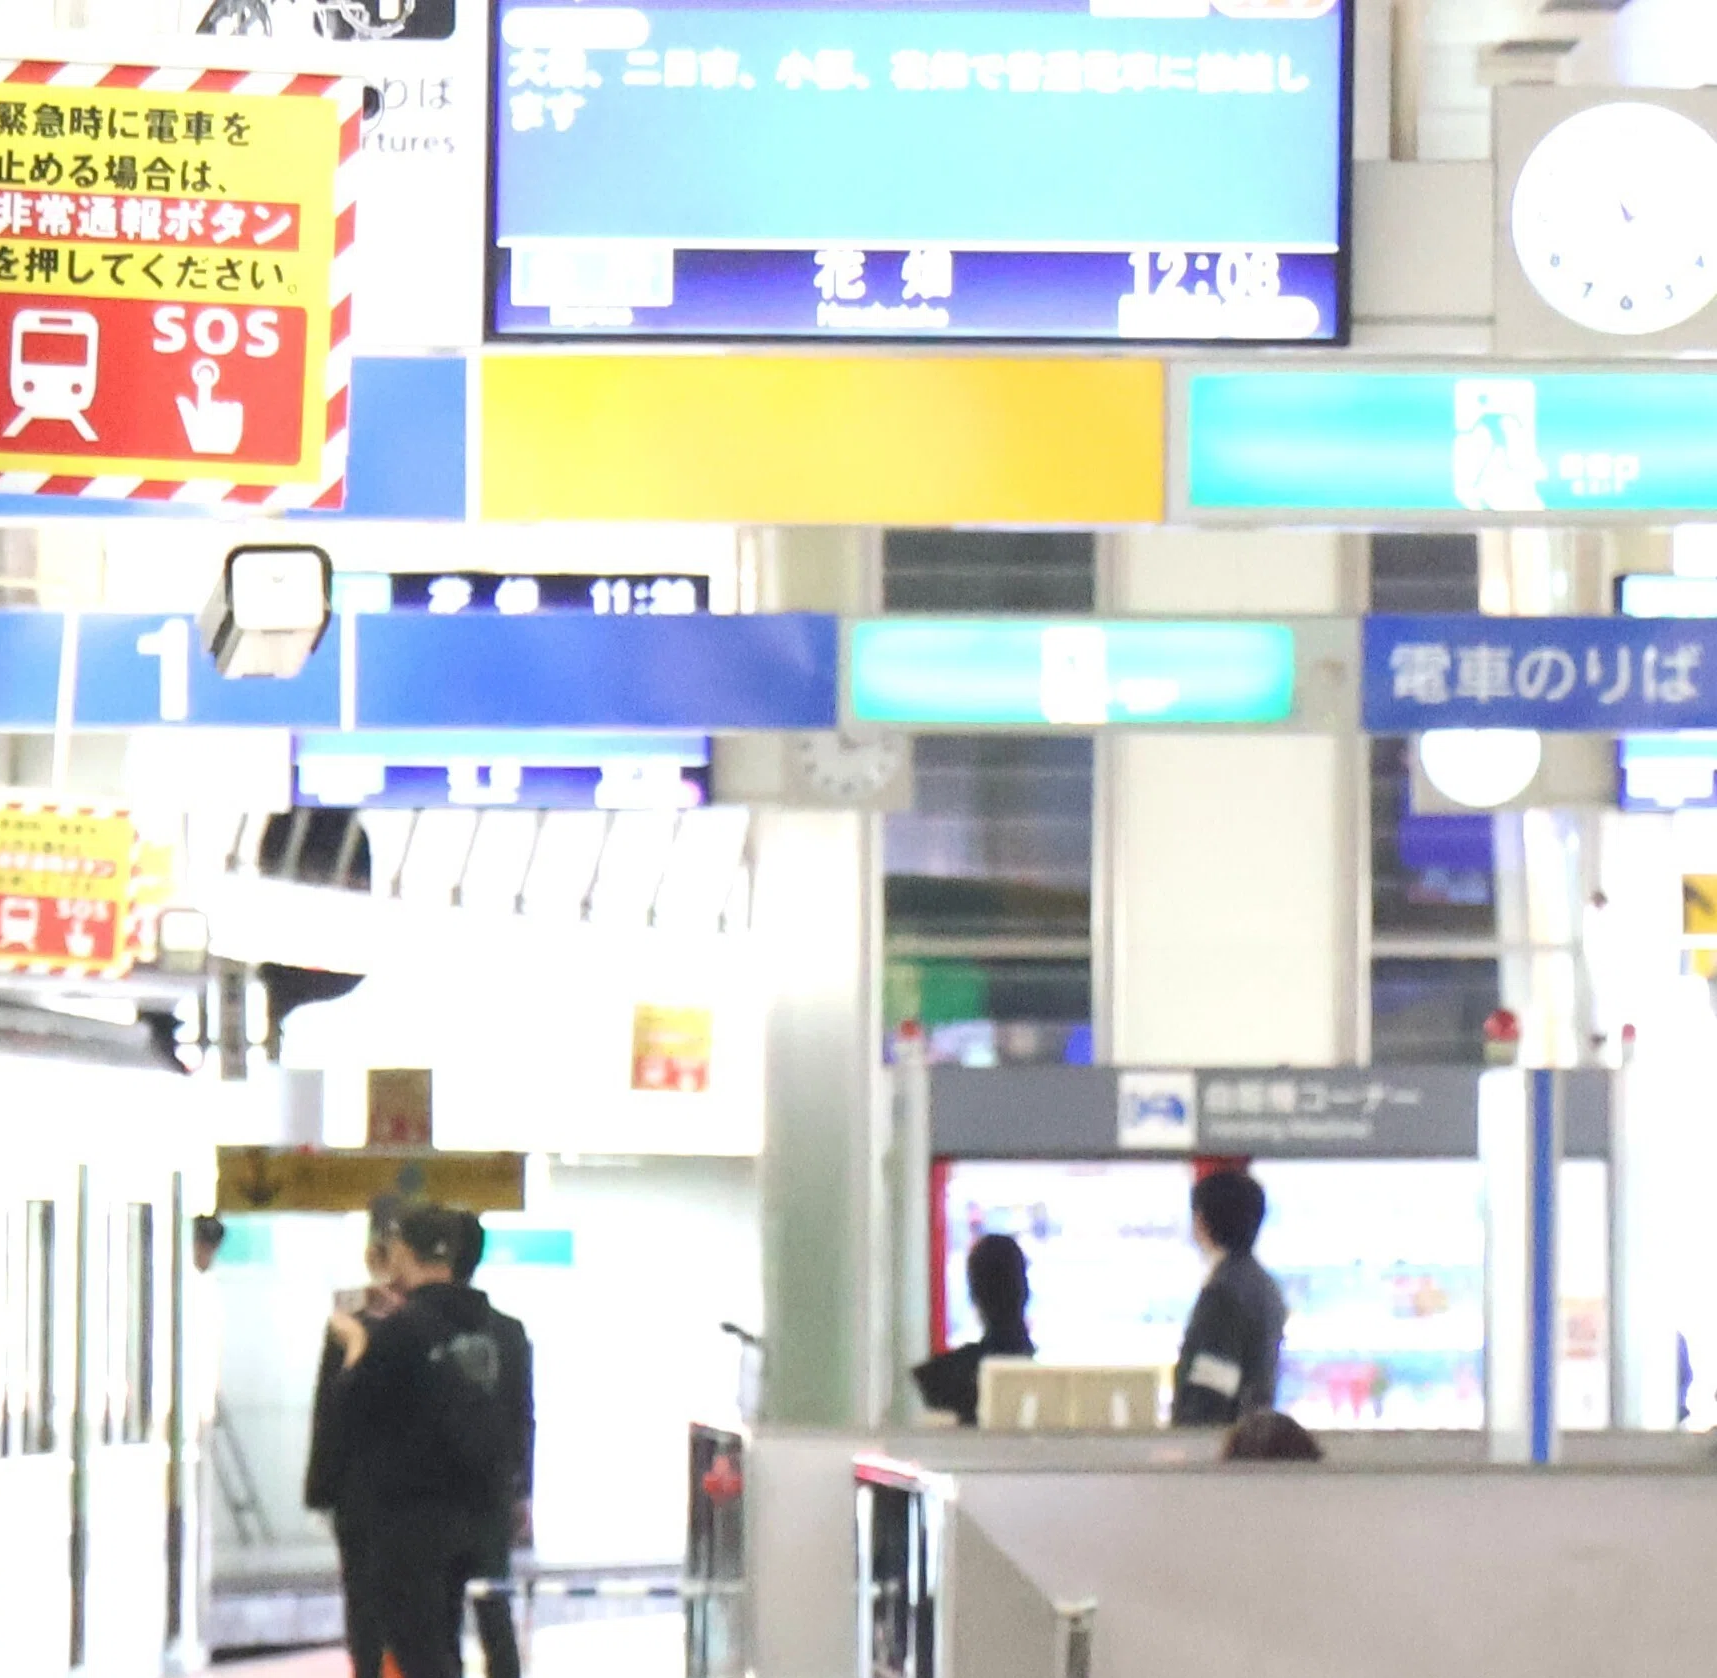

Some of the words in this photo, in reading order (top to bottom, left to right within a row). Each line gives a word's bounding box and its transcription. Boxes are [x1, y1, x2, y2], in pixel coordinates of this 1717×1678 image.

[151, 304, 281, 359] SOS
[136, 619, 190, 721] 1
[1390, 642, 1703, 705] 電車のりば
